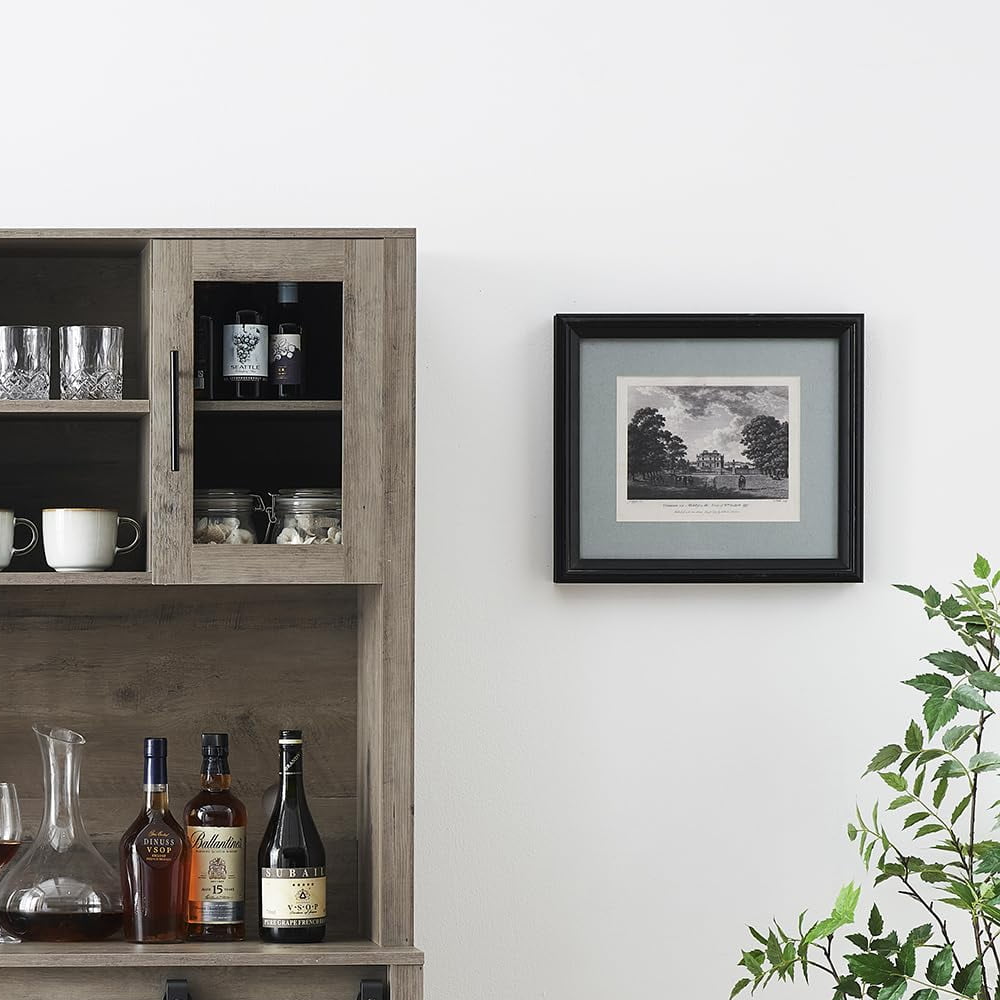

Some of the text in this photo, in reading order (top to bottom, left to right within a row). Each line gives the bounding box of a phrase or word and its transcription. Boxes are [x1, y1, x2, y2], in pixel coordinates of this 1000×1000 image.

[143, 838, 176, 846] DINUSS
[146, 846, 172, 854] VSOP
[212, 884, 223, 895] 15
